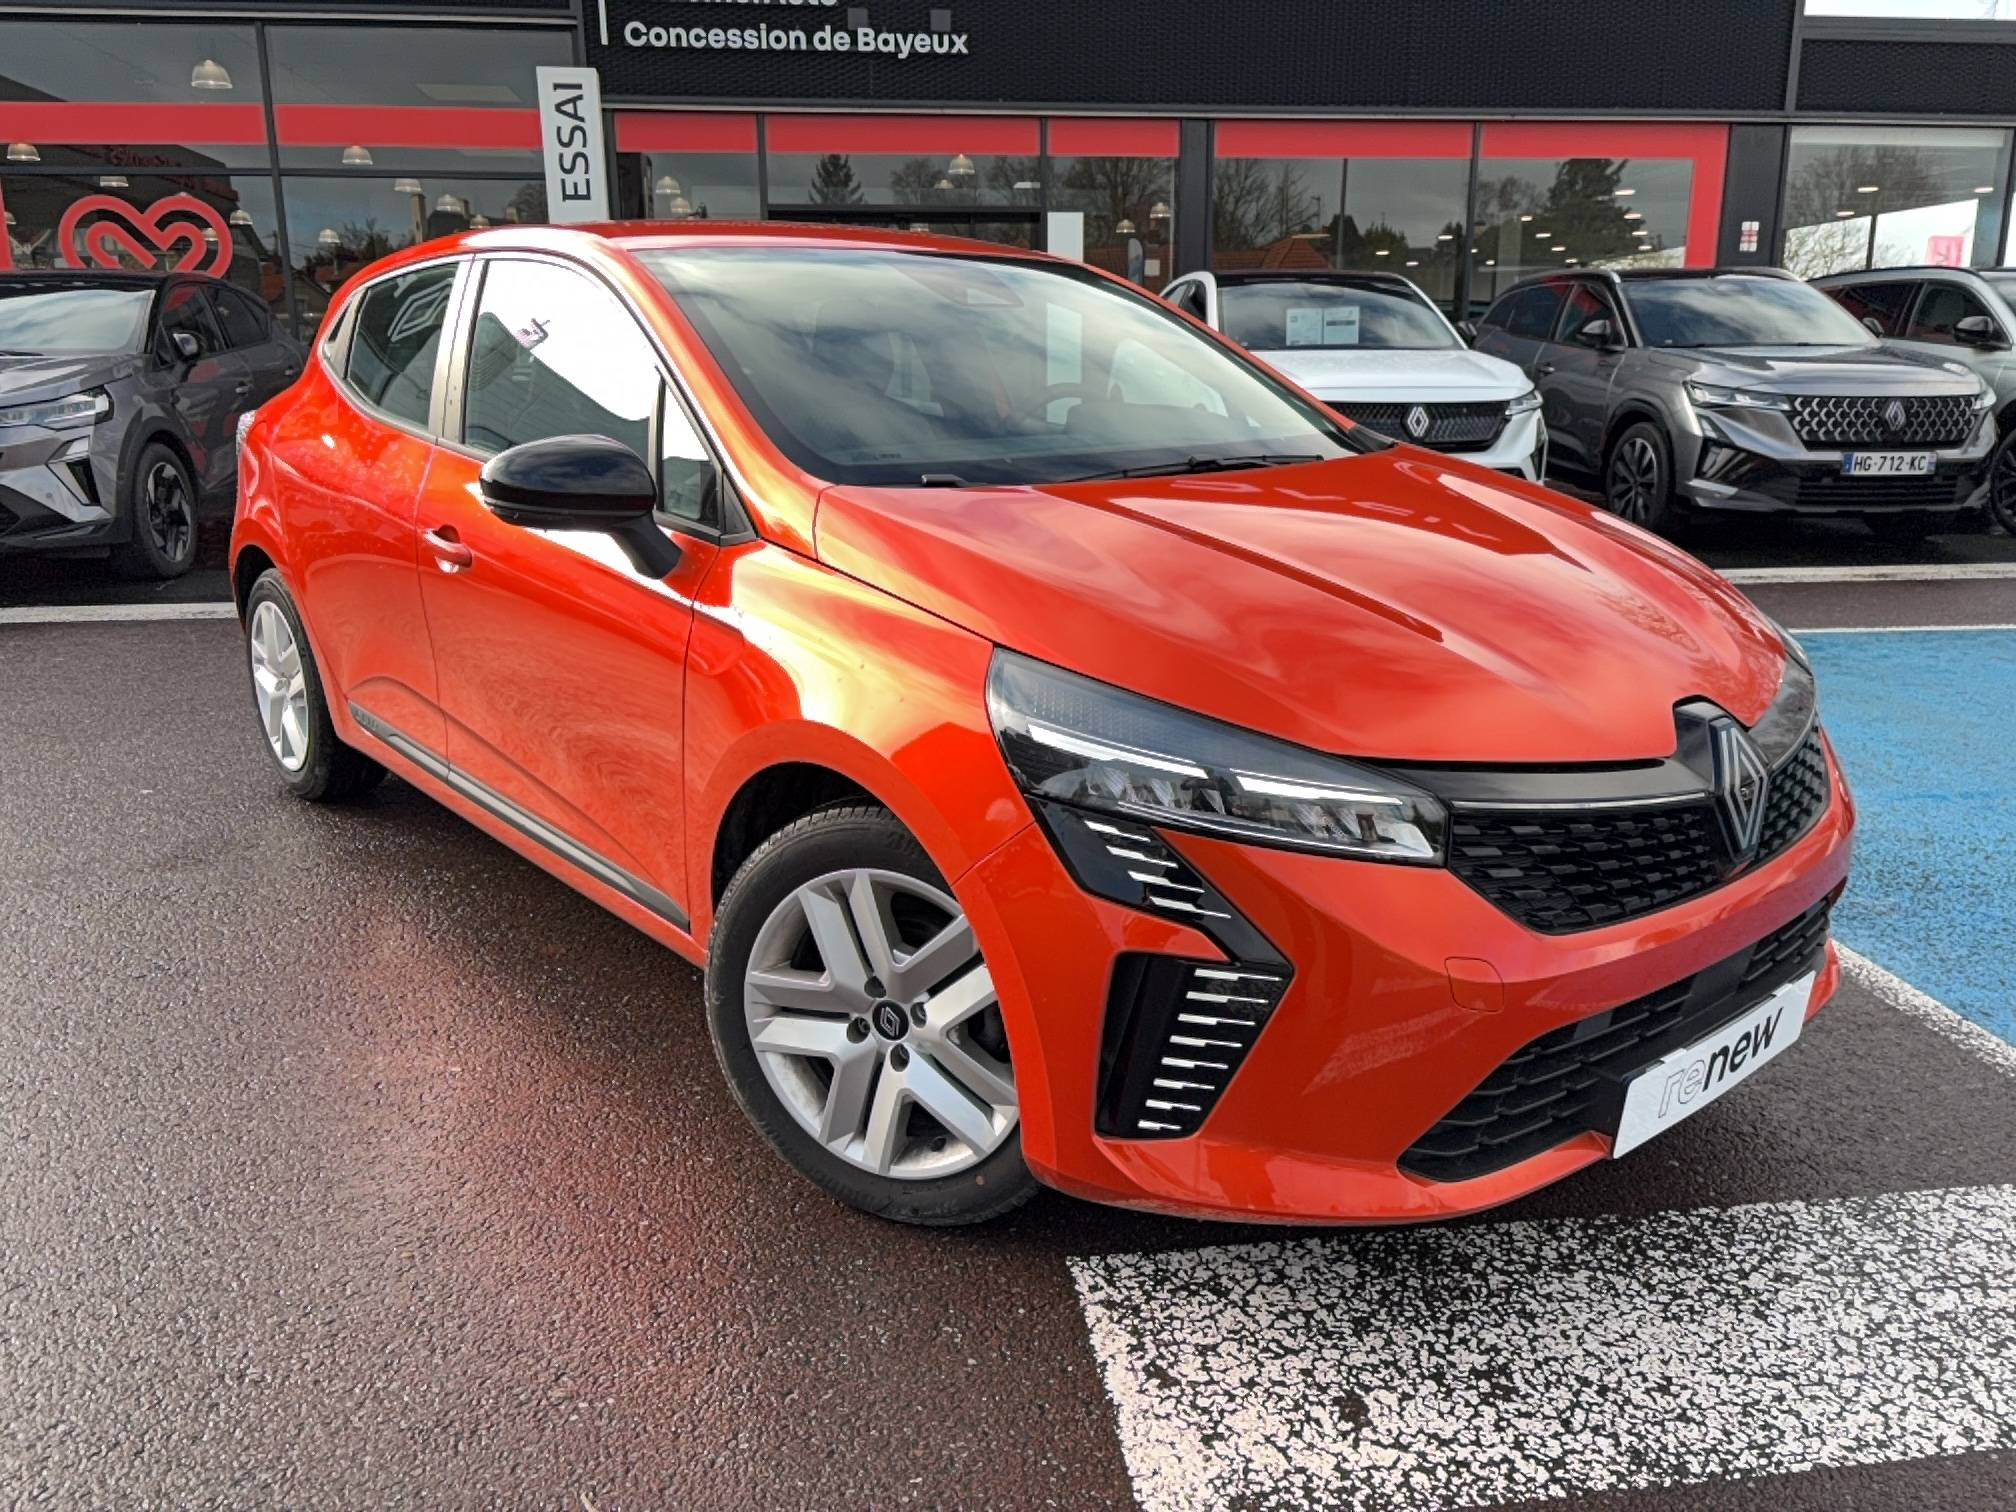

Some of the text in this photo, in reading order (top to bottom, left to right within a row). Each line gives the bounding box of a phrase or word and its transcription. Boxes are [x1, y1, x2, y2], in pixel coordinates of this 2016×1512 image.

[624, 21, 969, 59] Concession de Bayeux
[552, 82, 592, 203] ESSAI
[1853, 455, 1927, 472] HG-712-KC
[1658, 1006, 1784, 1119] renew
